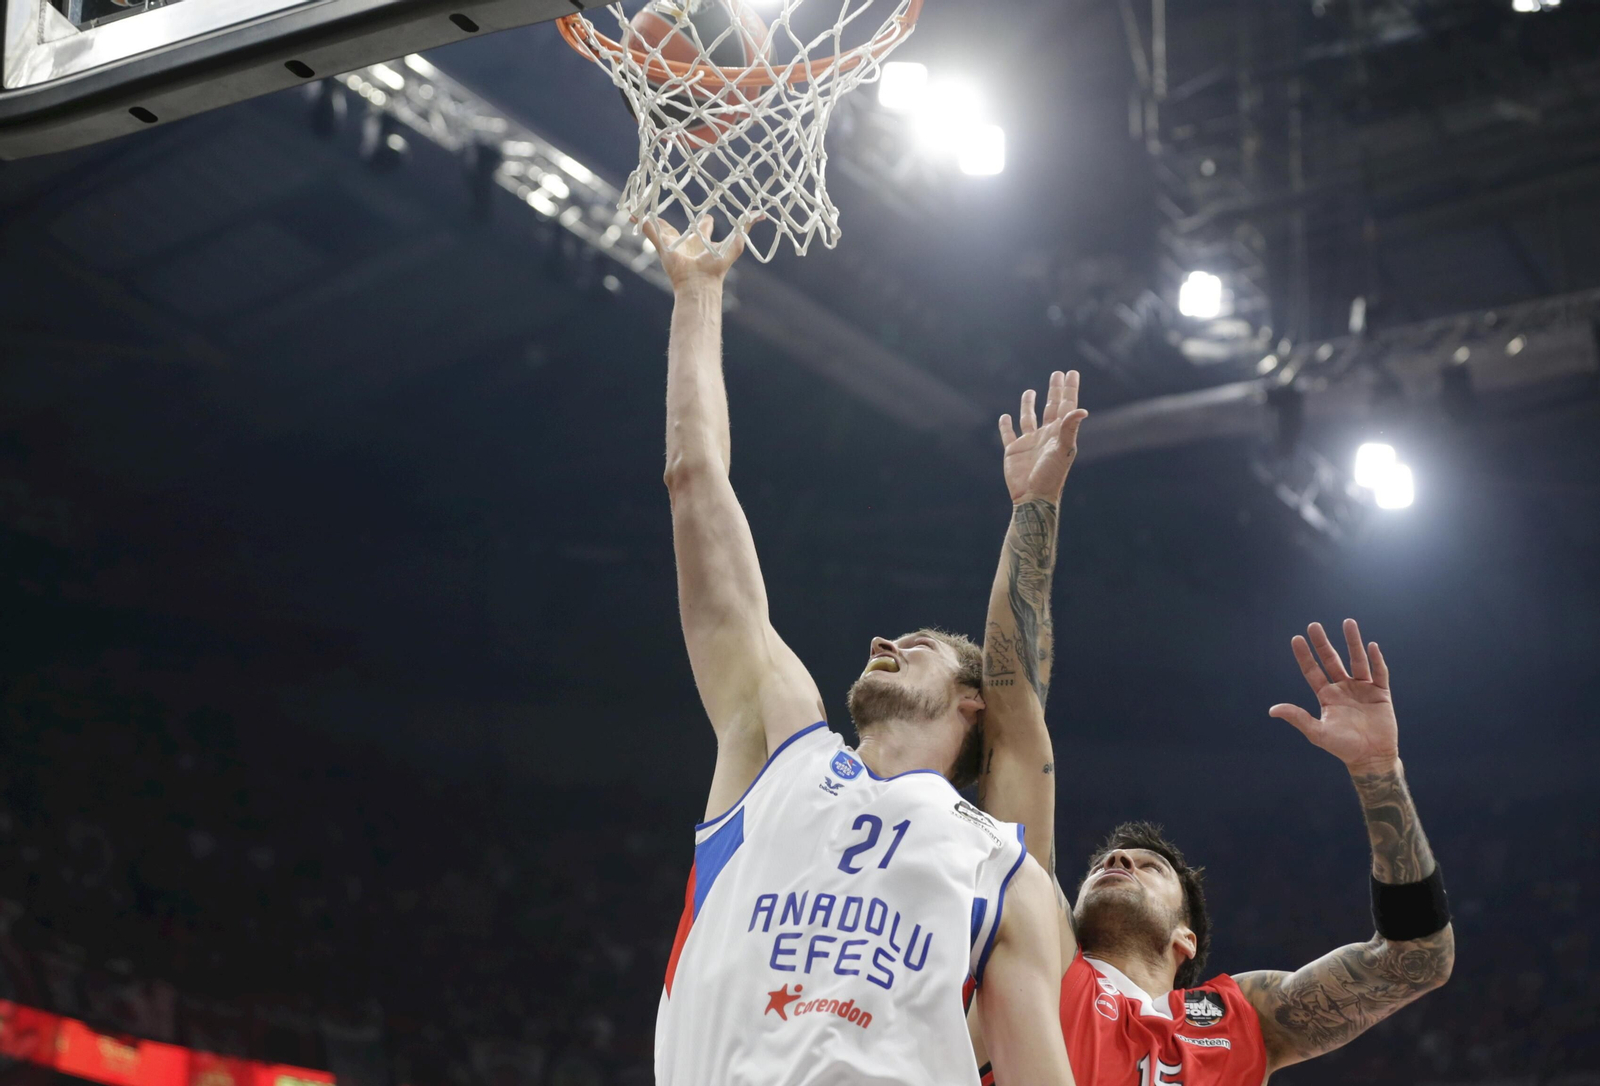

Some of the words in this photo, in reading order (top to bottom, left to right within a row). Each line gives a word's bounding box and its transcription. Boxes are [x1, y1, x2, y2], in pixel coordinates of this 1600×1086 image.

[837, 813, 911, 874] 21
[748, 890, 933, 972] ANADOLU
[769, 932, 896, 990] EFES
[793, 998, 873, 1029] corendon
[1184, 1000, 1218, 1010] FINAL
[1185, 1009, 1223, 1017] FOUR
[1136, 1053, 1184, 1086] 15
